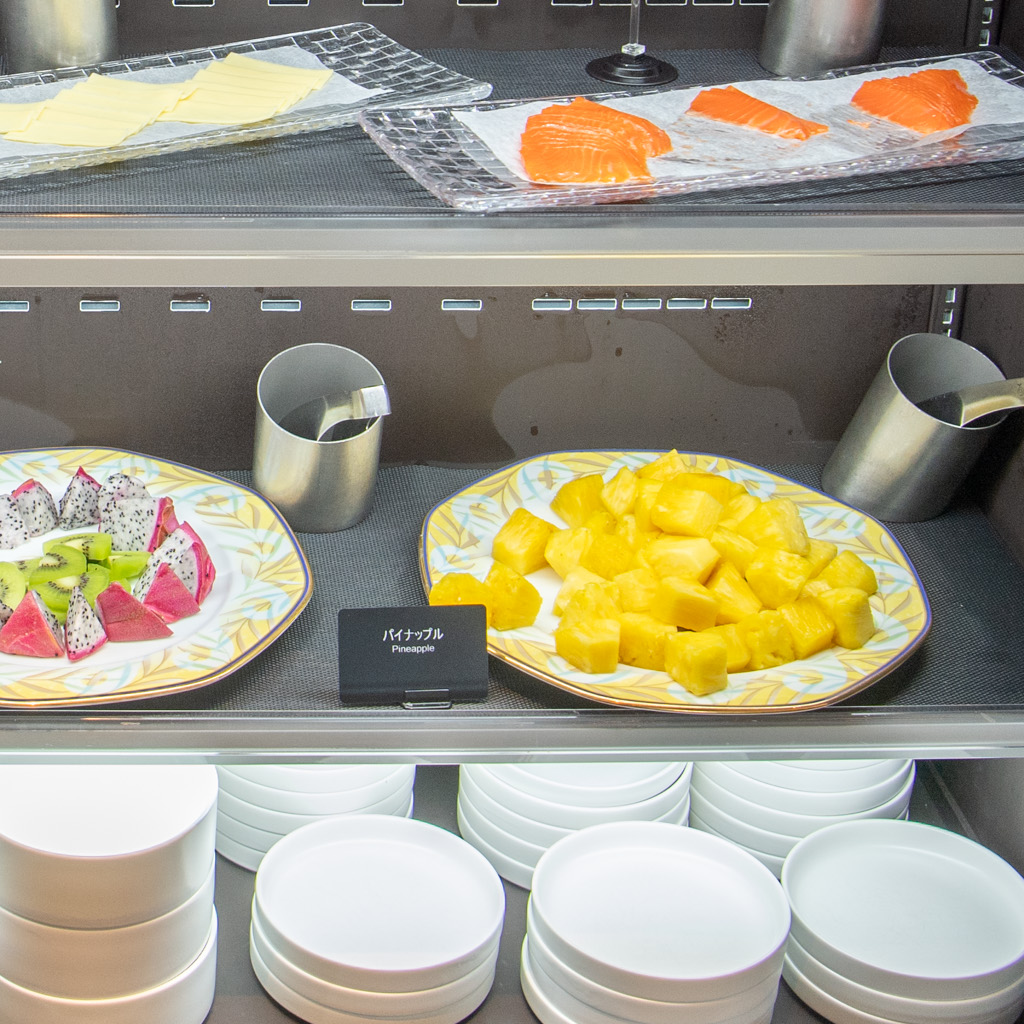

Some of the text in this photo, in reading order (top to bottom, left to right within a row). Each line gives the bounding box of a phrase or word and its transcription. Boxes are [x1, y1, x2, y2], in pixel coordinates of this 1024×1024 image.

[382, 628, 444, 642] パイナップル
[392, 644, 435, 653] Pineapple
